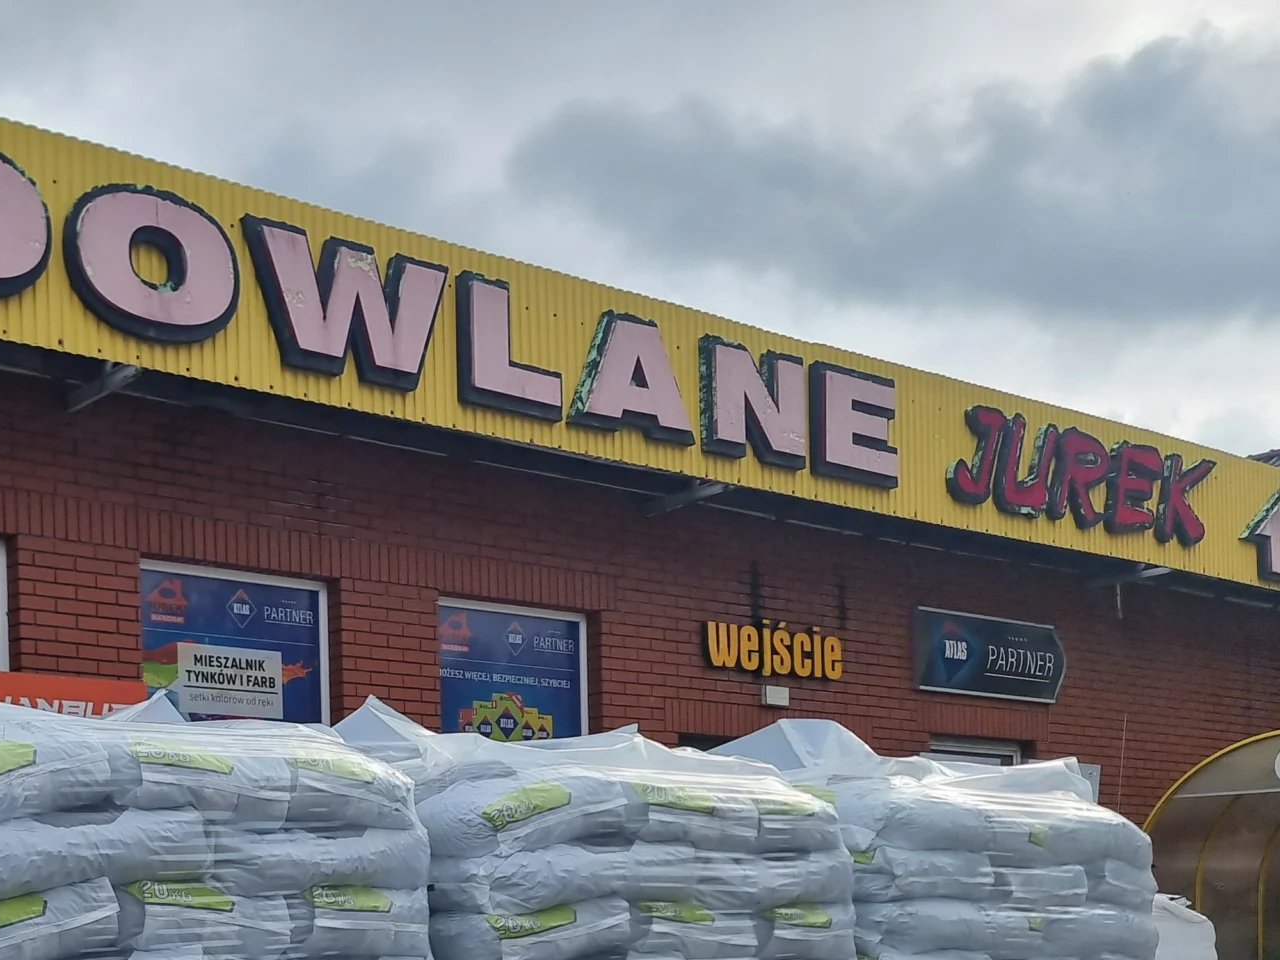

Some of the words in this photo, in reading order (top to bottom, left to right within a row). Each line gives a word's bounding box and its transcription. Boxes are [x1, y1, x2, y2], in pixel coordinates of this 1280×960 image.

[946, 404, 1217, 547] JUREK
[233, 603, 250, 615] ATLAS
[263, 606, 314, 624] PARTNER
[533, 635, 575, 652] PARTNER
[707, 618, 843, 680] wejście
[193, 653, 266, 672] MIESZALNIK
[944, 639, 967, 660] ATLAS
[987, 645, 1055, 676] PARTNER
[185, 669, 238, 685] TYNKÓW
[246, 675, 276, 689] FARB
[540, 677, 571, 690] SZYBCIEJ
[189, 692, 210, 703] setki
[210, 692, 246, 705] kolorów
[246, 695, 257, 706] od
[257, 697, 274, 709] ręki
